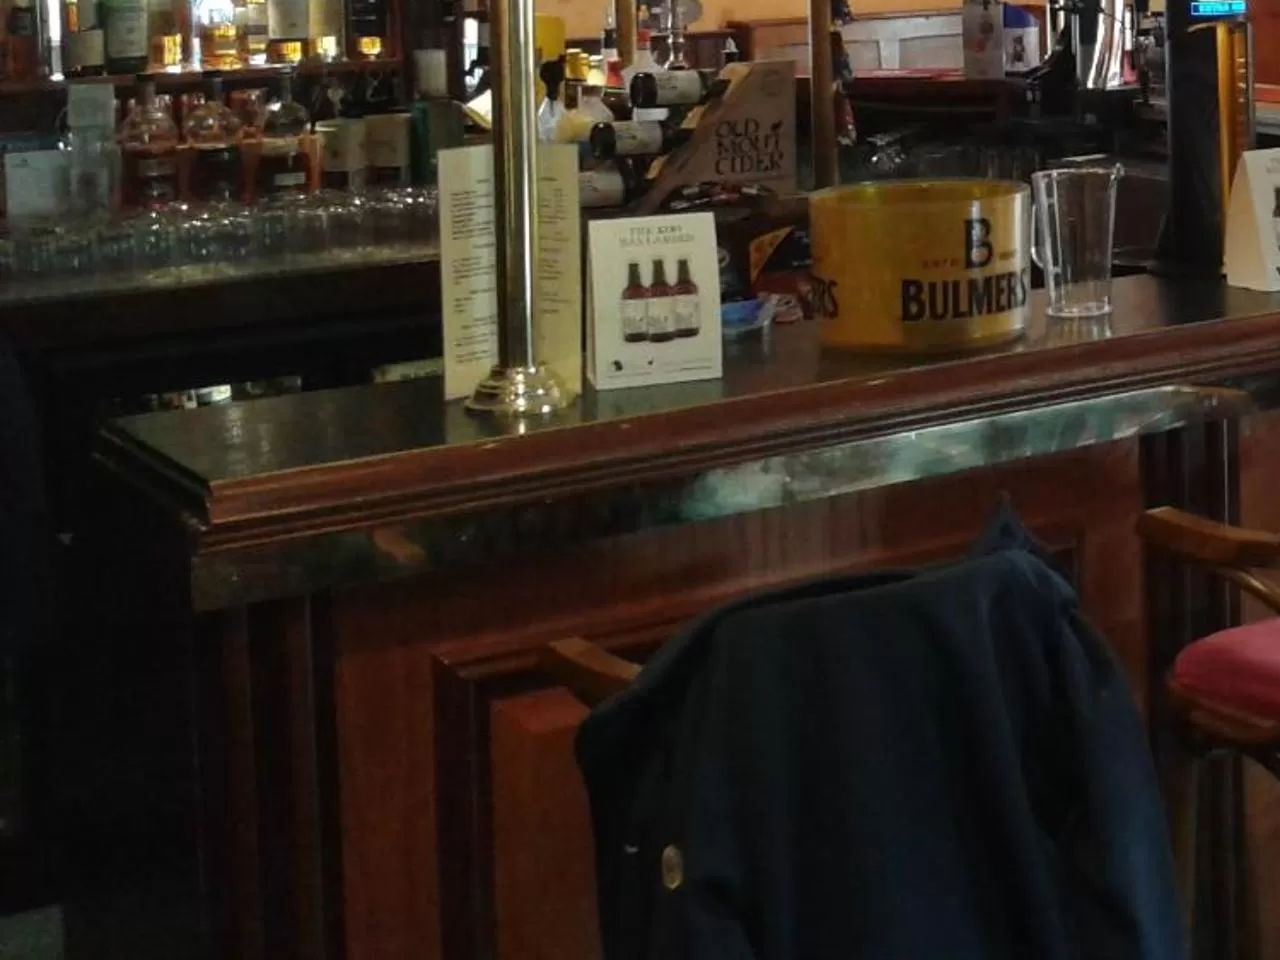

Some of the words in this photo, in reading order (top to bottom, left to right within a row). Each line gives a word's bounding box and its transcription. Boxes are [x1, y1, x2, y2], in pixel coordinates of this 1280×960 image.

[715, 118, 760, 138] OLD
[715, 152, 782, 176] CIDER
[964, 218, 993, 270] B
[902, 268, 1026, 321] BULMERS
